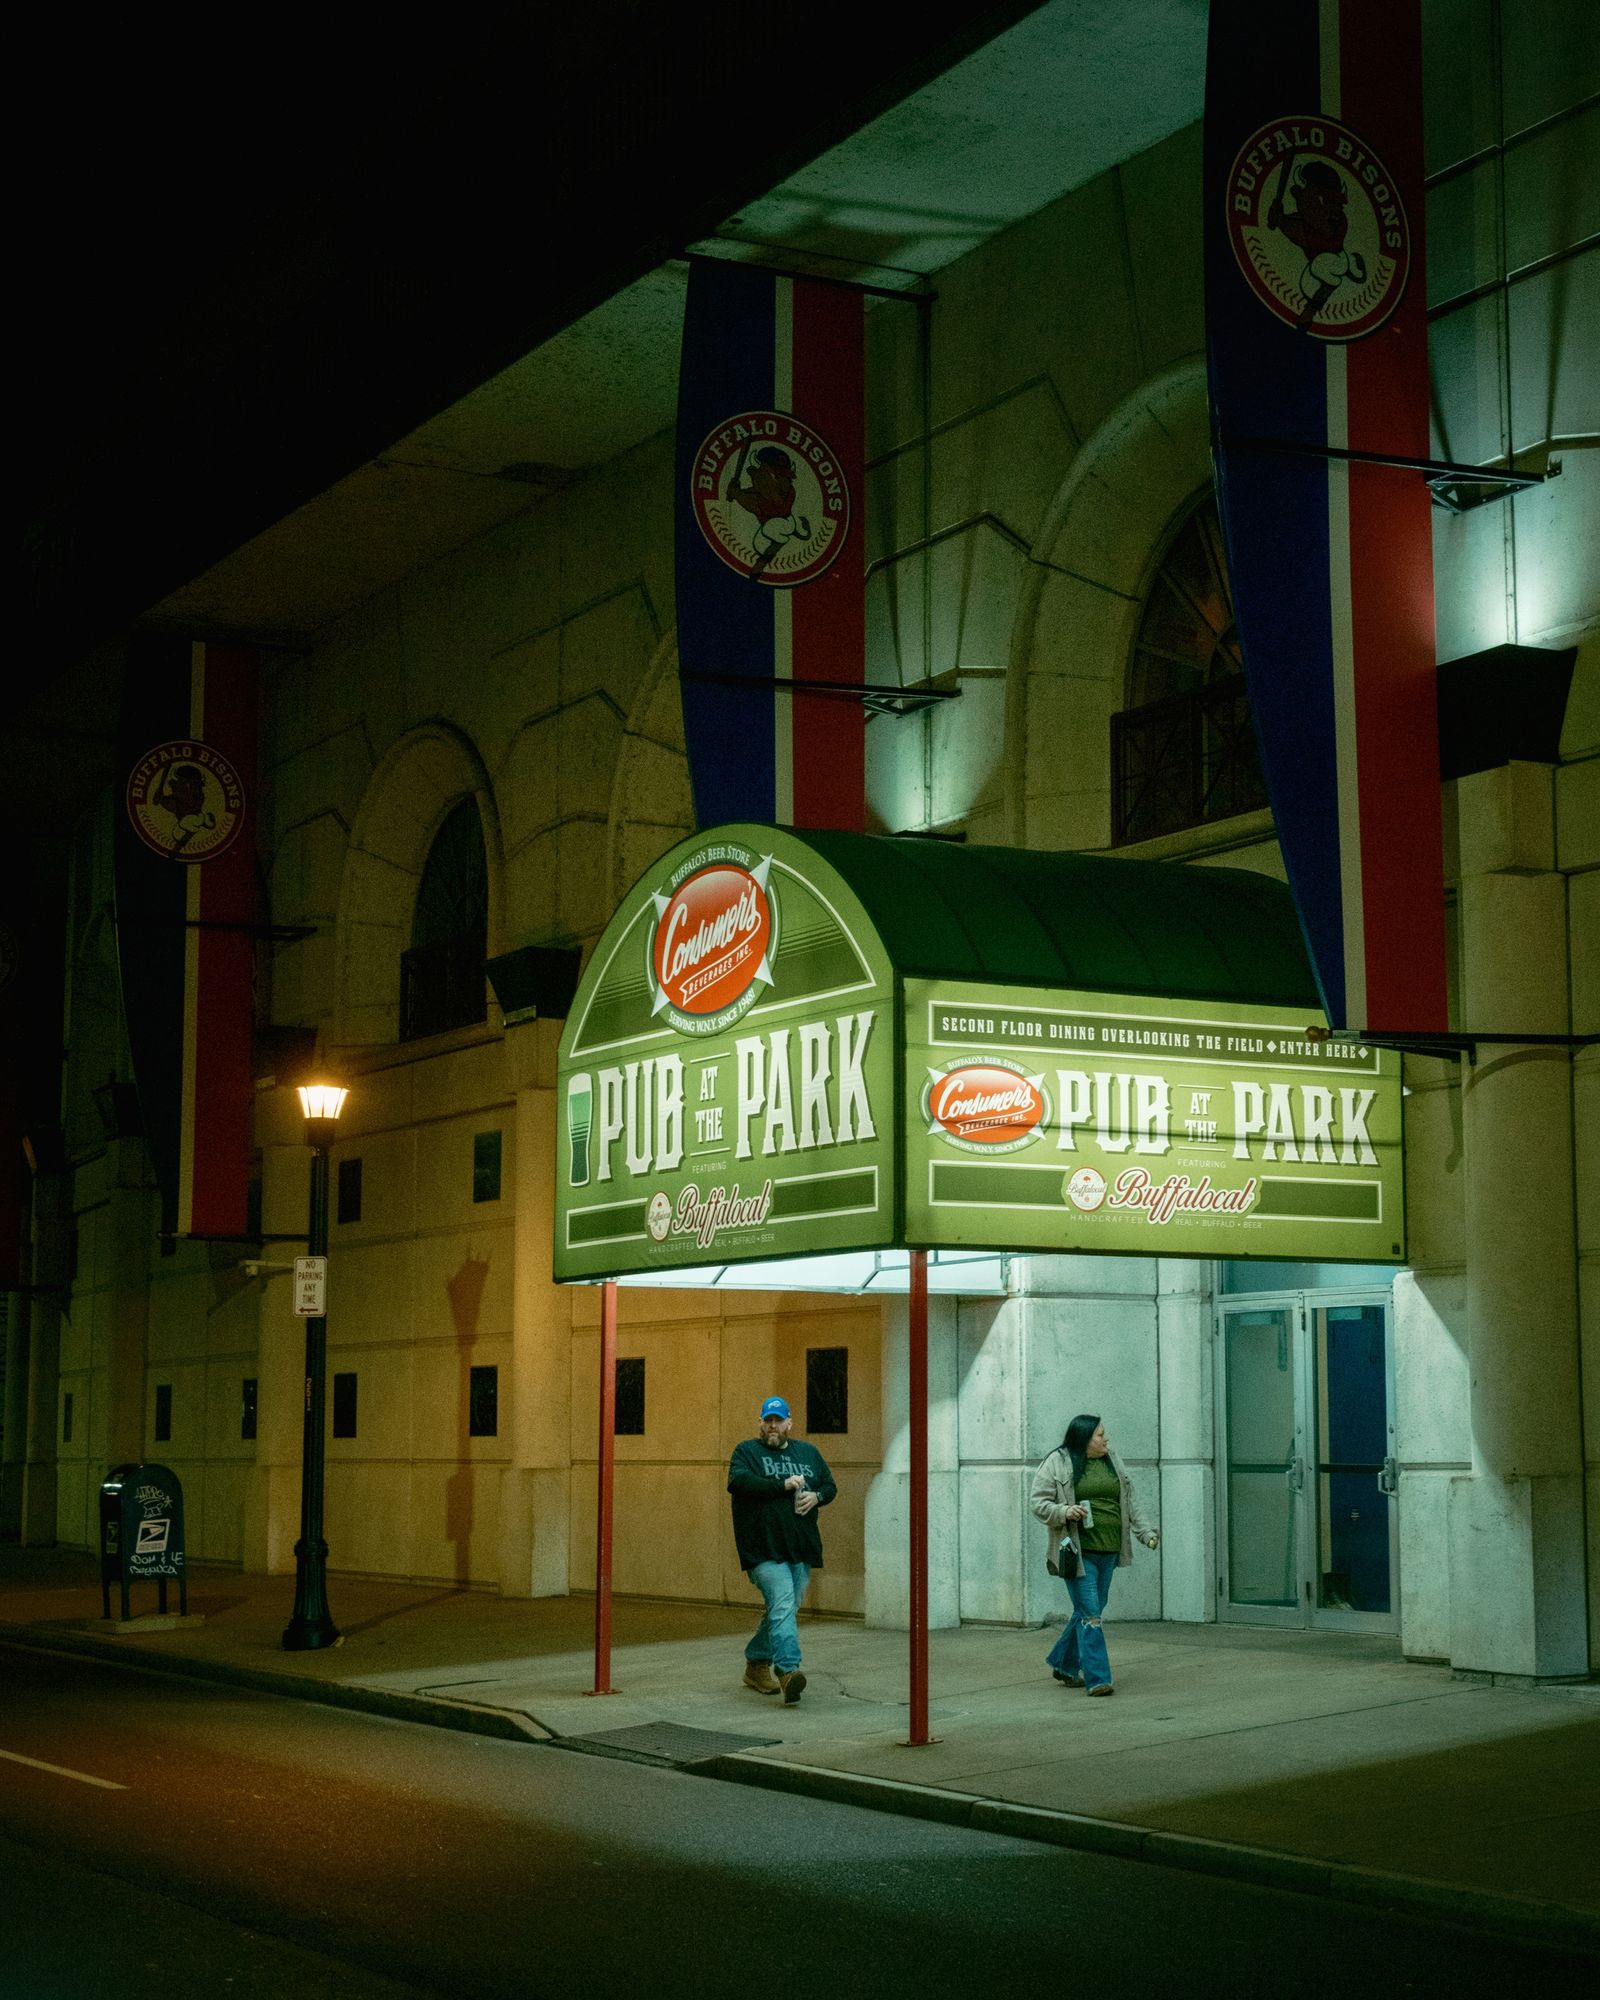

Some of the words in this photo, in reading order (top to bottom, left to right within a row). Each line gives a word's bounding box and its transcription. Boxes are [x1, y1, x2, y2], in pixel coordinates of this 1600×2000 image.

[1235, 127, 1325, 216] BUFFALO
[1335, 137, 1401, 248] BISONS
[699, 420, 777, 491] BUFFALO
[786, 427, 842, 512] BISONS
[132, 746, 192, 798] BUFFALO
[199, 750, 240, 808] BISONS
[707, 847, 726, 861] BEER
[727, 845, 750, 866] STORE
[662, 880, 760, 985] Consumer's
[688, 957, 732, 995] BEVERAGES
[668, 1010, 695, 1033] SERVING
[717, 1010, 738, 1028] SINCE
[942, 1017, 995, 1034] SECOND
[1001, 1020, 1043, 1037] FLOOR
[1049, 1024, 1095, 1041] DINING
[1101, 1028, 1190, 1047] OVERLOOKING
[1196, 1035, 1221, 1050] THE
[1227, 1037, 1263, 1053] FIELD
[1279, 1041, 1320, 1057] ENTER
[1326, 1044, 1356, 1059] HERE
[700, 1066, 718, 1102] AT
[734, 1010, 877, 1159] PARK
[938, 1079, 1034, 1120] Consumer's
[597, 1053, 684, 1181] PUB
[1055, 1069, 1173, 1154] PUB
[1189, 1092, 1211, 1116] AT
[695, 1107, 723, 1144] THE
[1184, 1119, 1218, 1144] THE
[1230, 1081, 1378, 1165] PARK
[692, 1161, 727, 1174] FEATURING
[1178, 1158, 1226, 1169] FEATURING
[672, 1179, 771, 1249] Buffalocal
[1109, 1167, 1256, 1224] Buffalocal
[1070, 1214, 1143, 1224] HANDCRAFTED
[1175, 1218, 1194, 1226] REAL
[1202, 1219, 1235, 1228] BUFFALO
[298, 1271, 323, 1280] PARKING
[306, 1260, 316, 1269] NO
[303, 1294, 316, 1304] TIME
[304, 1283, 316, 1291] ANY
[761, 1456, 814, 1477] BEATLES
